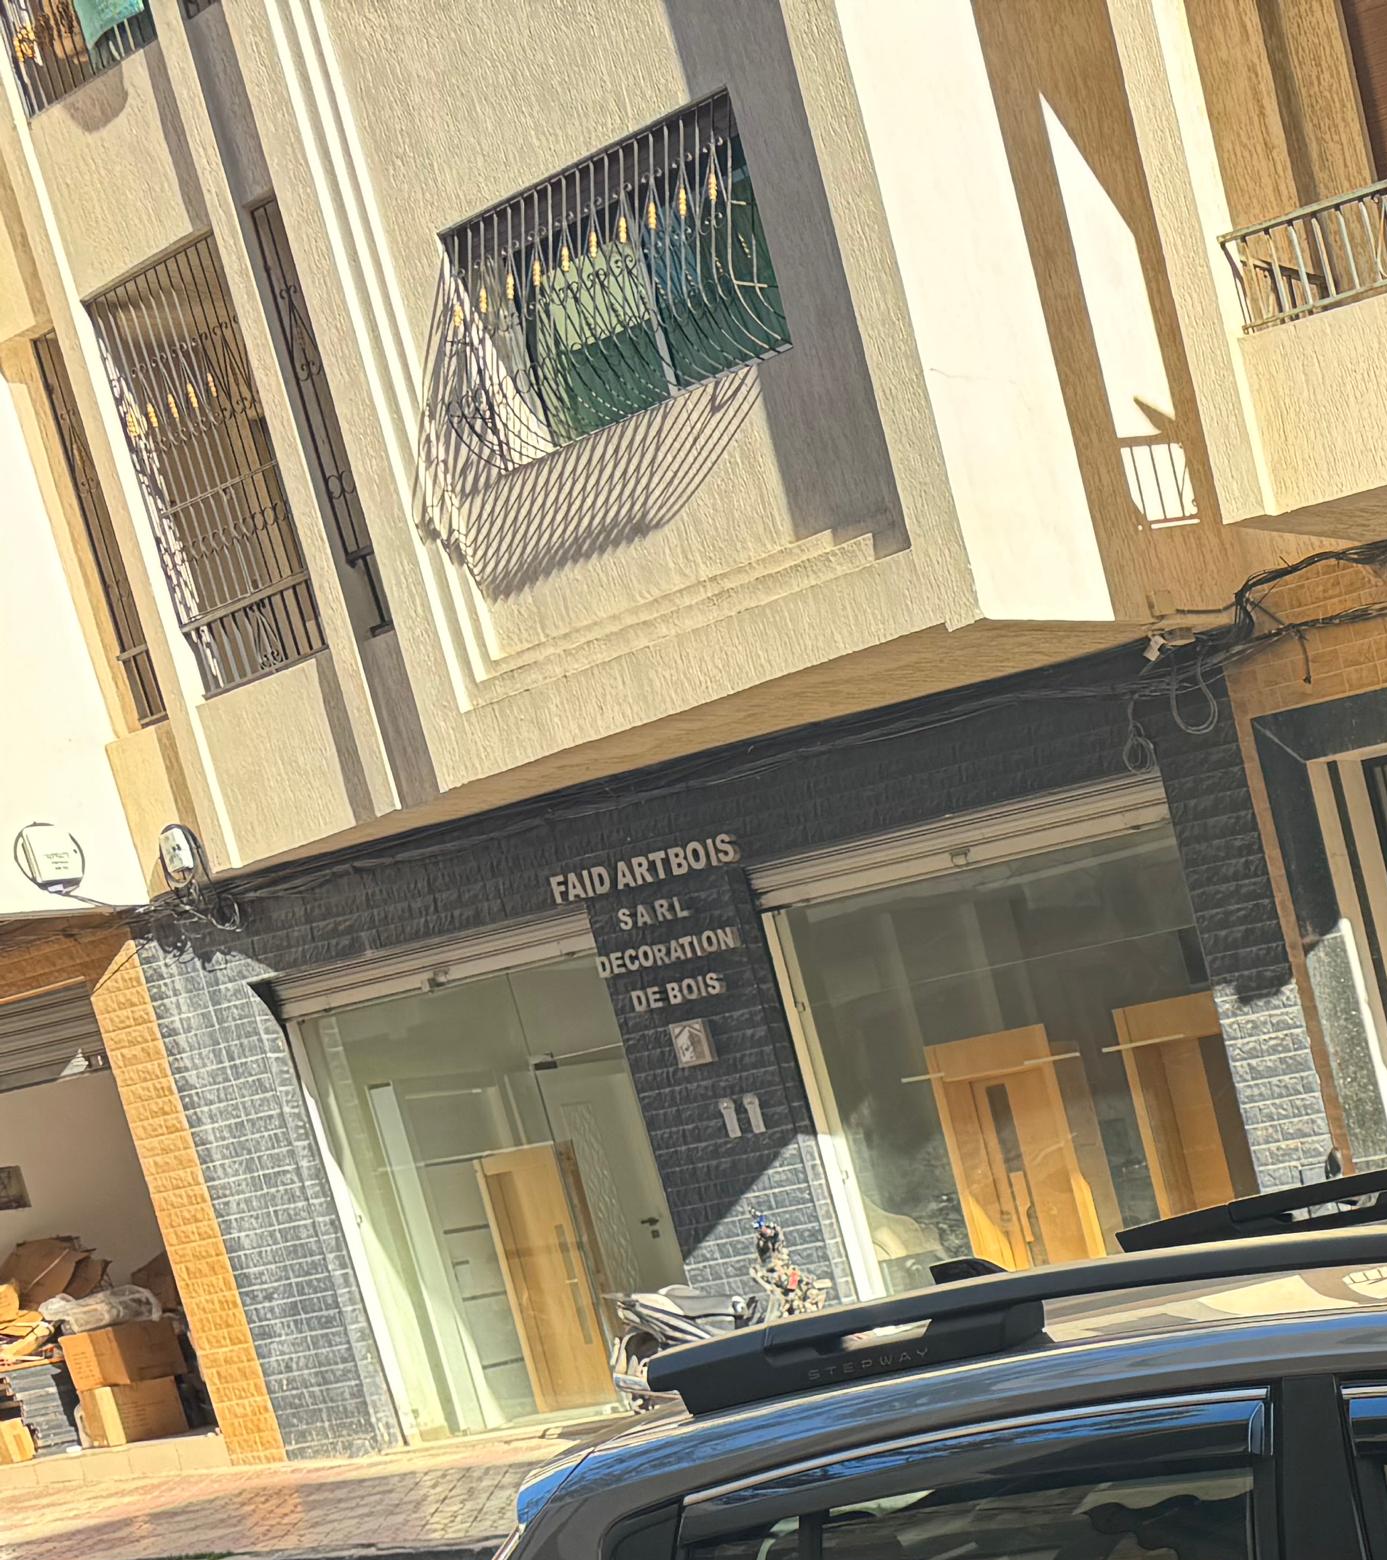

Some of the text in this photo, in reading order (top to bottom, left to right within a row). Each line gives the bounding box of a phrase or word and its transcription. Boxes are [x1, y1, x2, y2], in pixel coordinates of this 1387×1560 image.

[550, 833, 739, 904] FAID ARTBOIS
[596, 926, 739, 979] DECORATION
[630, 972, 726, 1013] DE BOIS
[808, 1347, 928, 1381] STEPWAY
